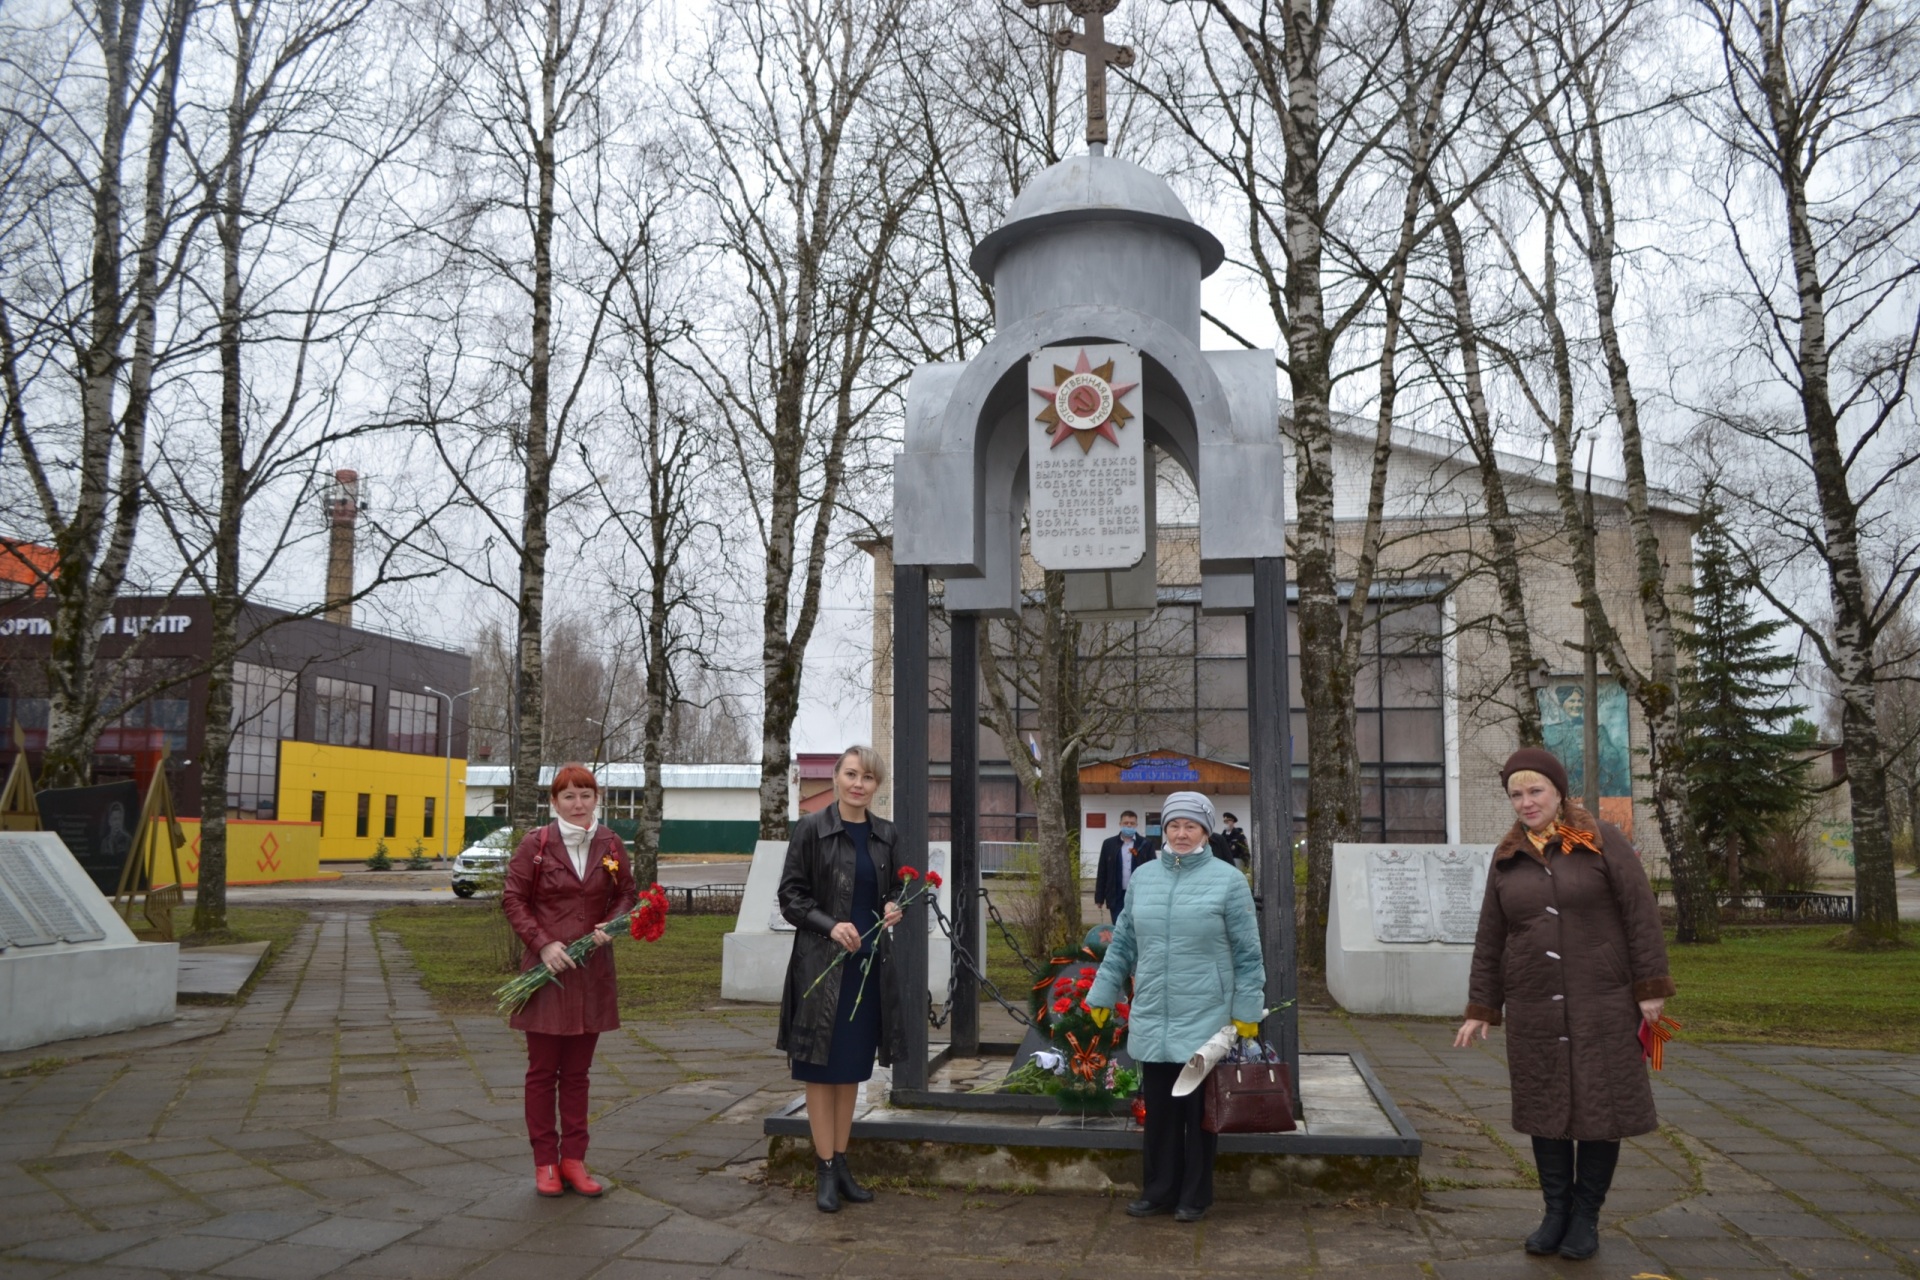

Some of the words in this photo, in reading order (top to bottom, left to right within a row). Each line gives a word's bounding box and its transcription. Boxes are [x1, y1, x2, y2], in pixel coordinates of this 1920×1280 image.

[1059, 376, 1107, 422] ОТЕЧЕСТВЕННАЯ
[1089, 395, 1110, 424] ВОЙНА
[1036, 518, 1079, 528] ВОЙНА
